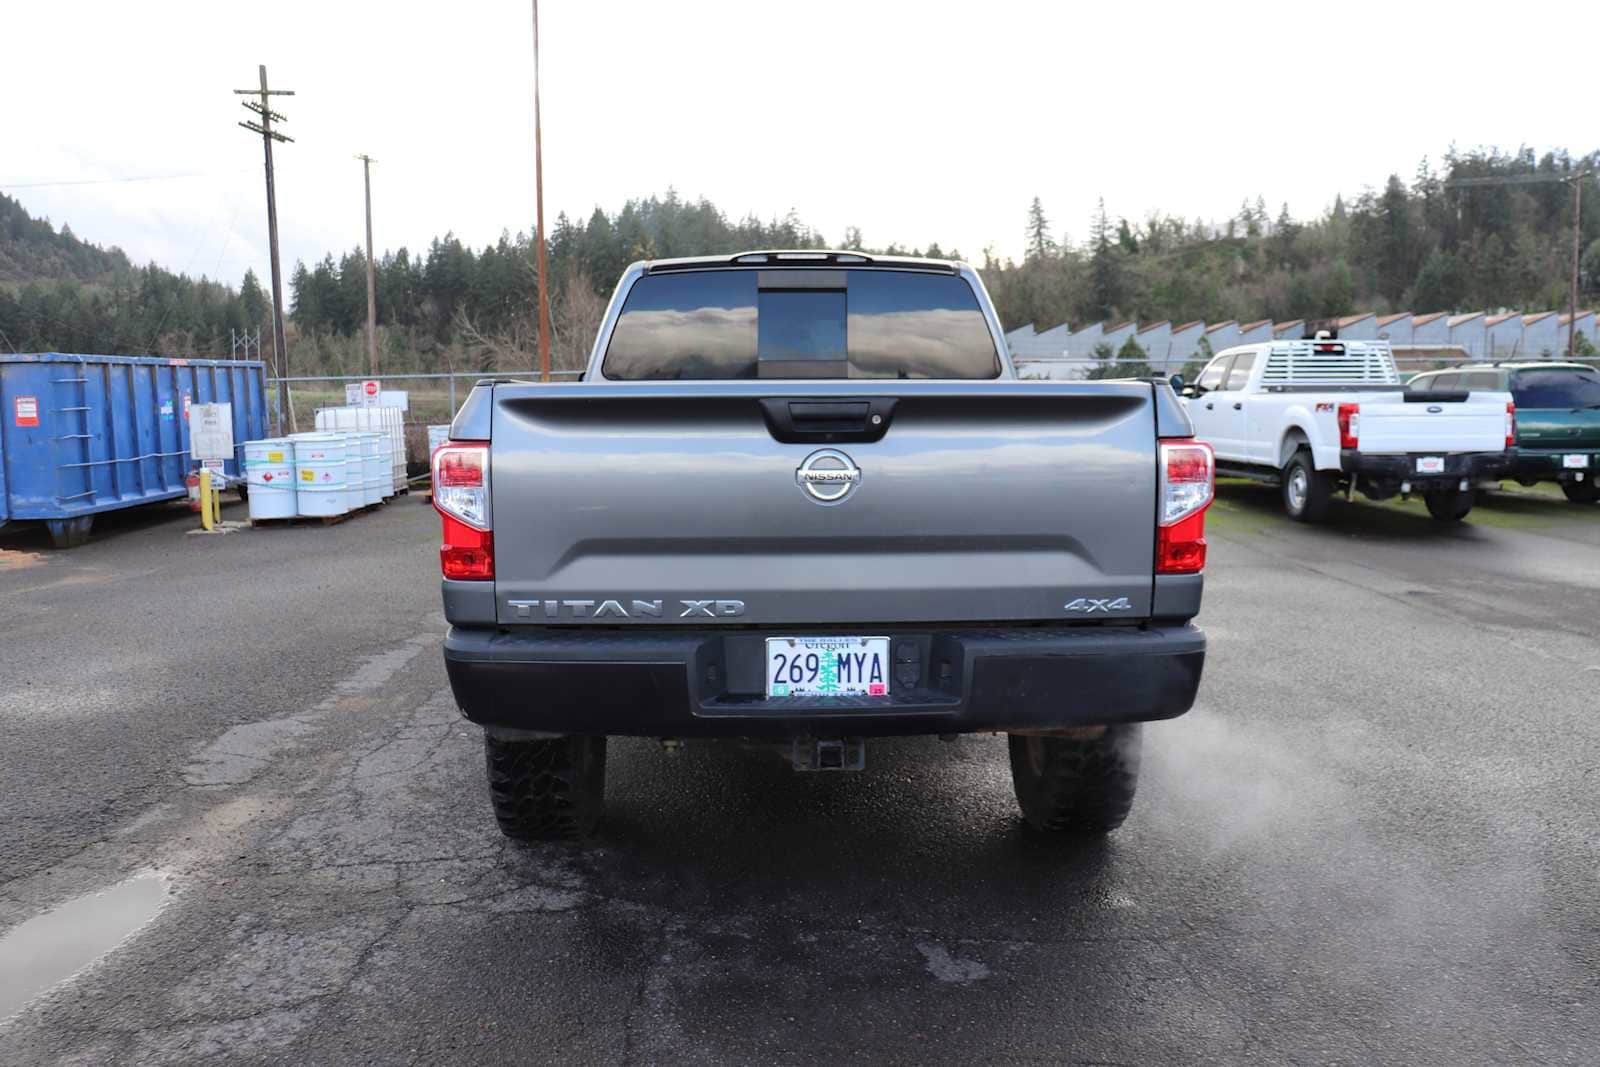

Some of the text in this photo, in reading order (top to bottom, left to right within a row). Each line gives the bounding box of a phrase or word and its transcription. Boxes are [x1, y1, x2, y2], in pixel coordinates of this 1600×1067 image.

[804, 473, 853, 481] NISSAN
[508, 599, 745, 618] TITAN XD
[773, 653, 882, 683] 269 MYA
